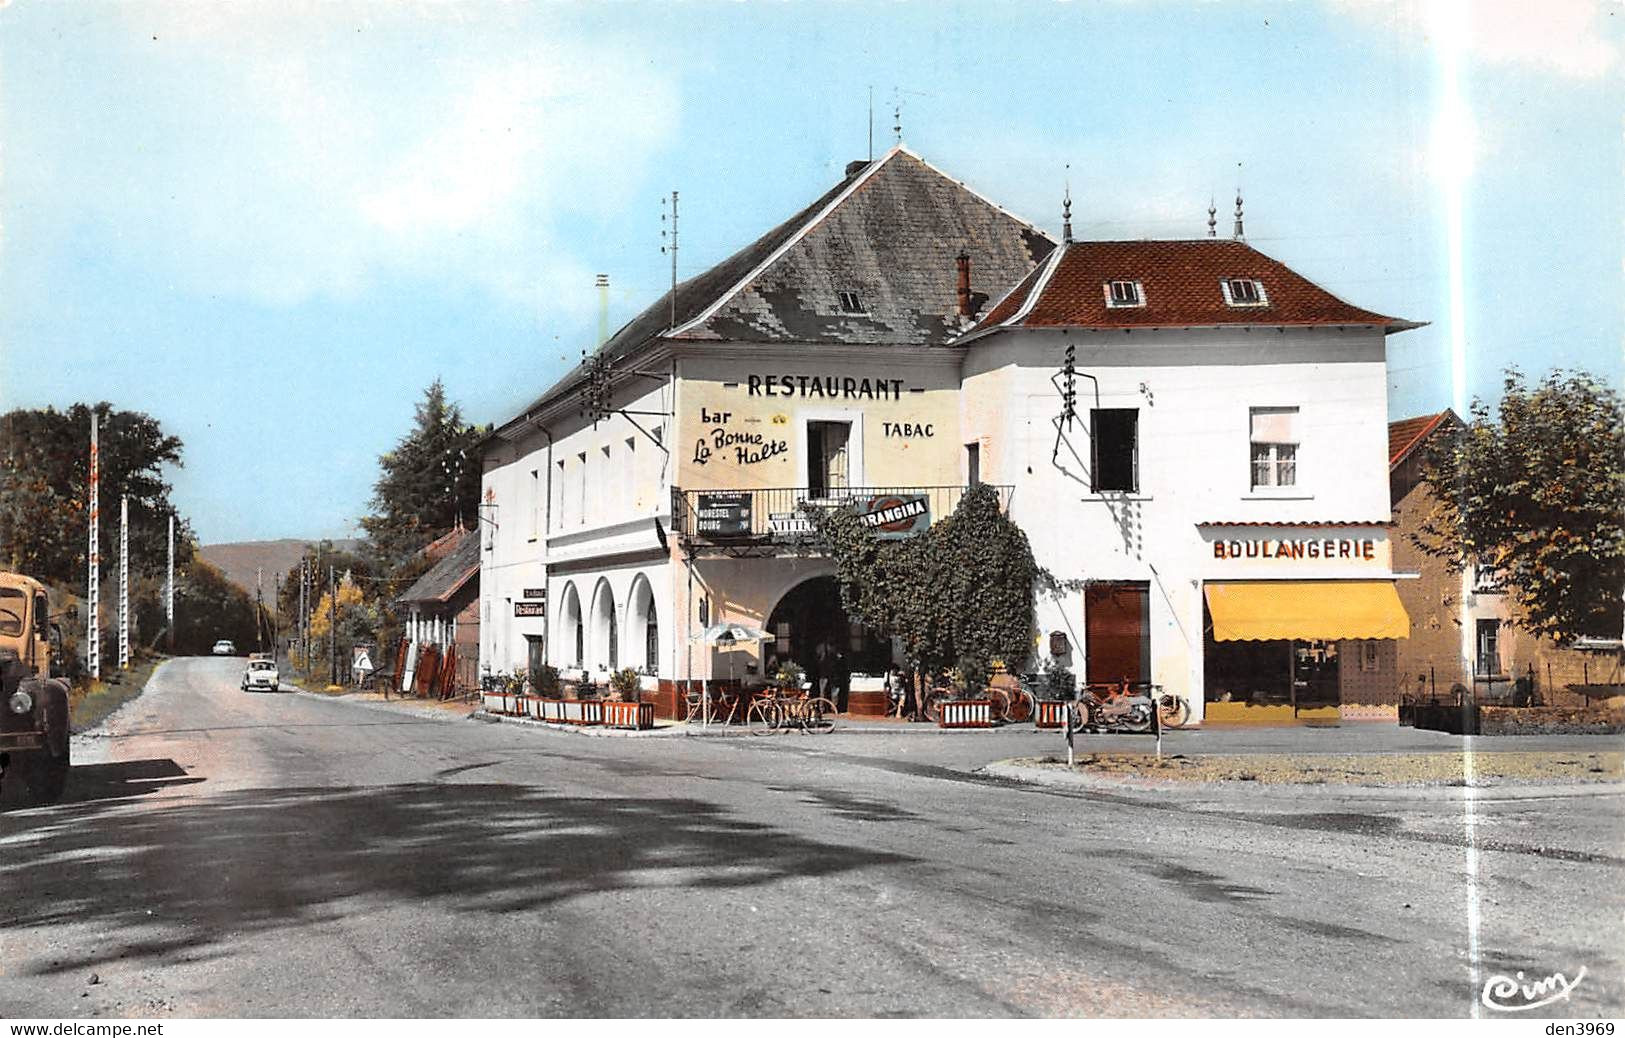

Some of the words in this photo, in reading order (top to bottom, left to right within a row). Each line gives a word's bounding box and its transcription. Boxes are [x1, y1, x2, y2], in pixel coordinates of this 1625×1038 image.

[748, 374, 904, 400] RESTAURANT
[701, 407, 732, 424] bar
[710, 427, 763, 449] Bonne
[882, 422, 935, 438] TABAC
[692, 438, 713, 465] La
[734, 439, 788, 465] Halte
[1213, 540, 1376, 560] BOULANGERIE
